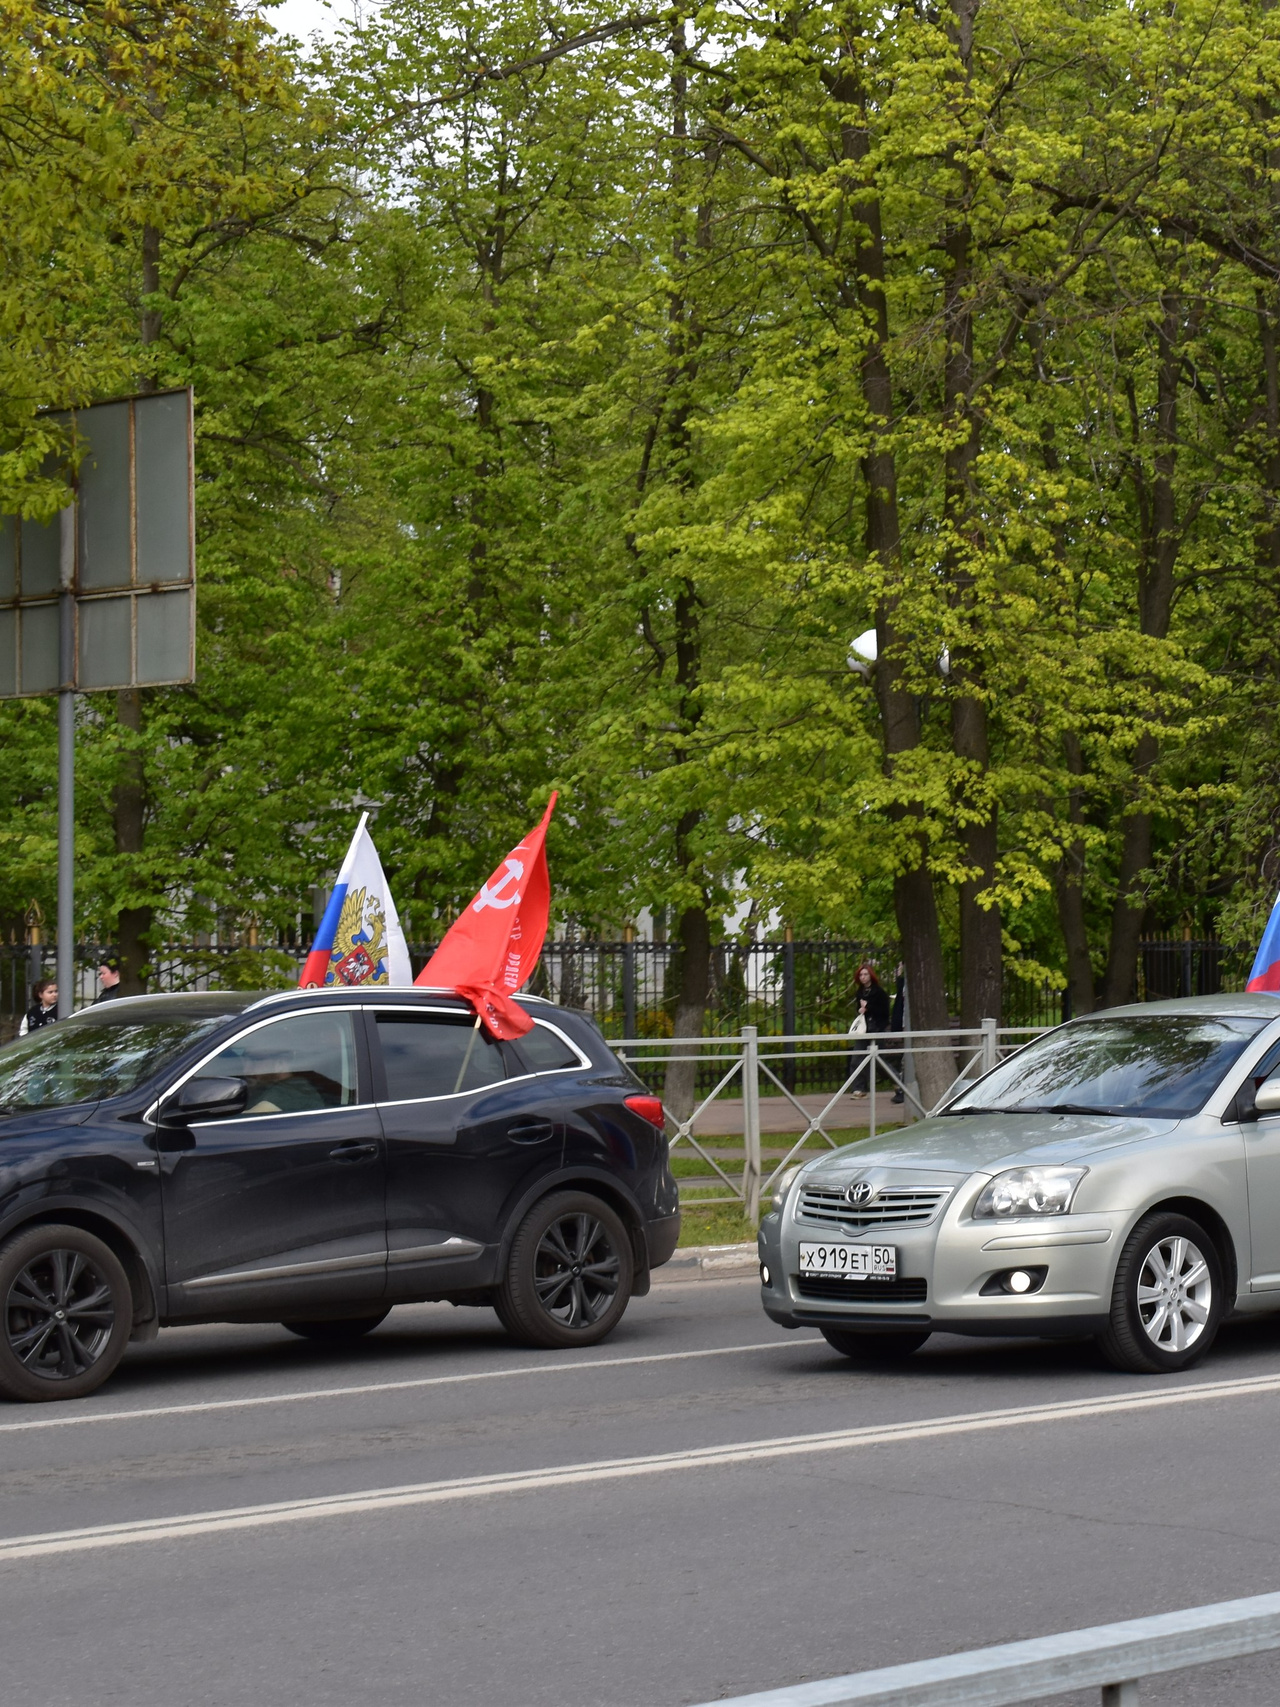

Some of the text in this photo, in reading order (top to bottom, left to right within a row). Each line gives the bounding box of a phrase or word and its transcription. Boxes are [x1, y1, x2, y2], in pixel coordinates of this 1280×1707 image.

[805, 1246, 890, 1270] Х919ЕТ 50
[873, 1264, 886, 1272] RUS
